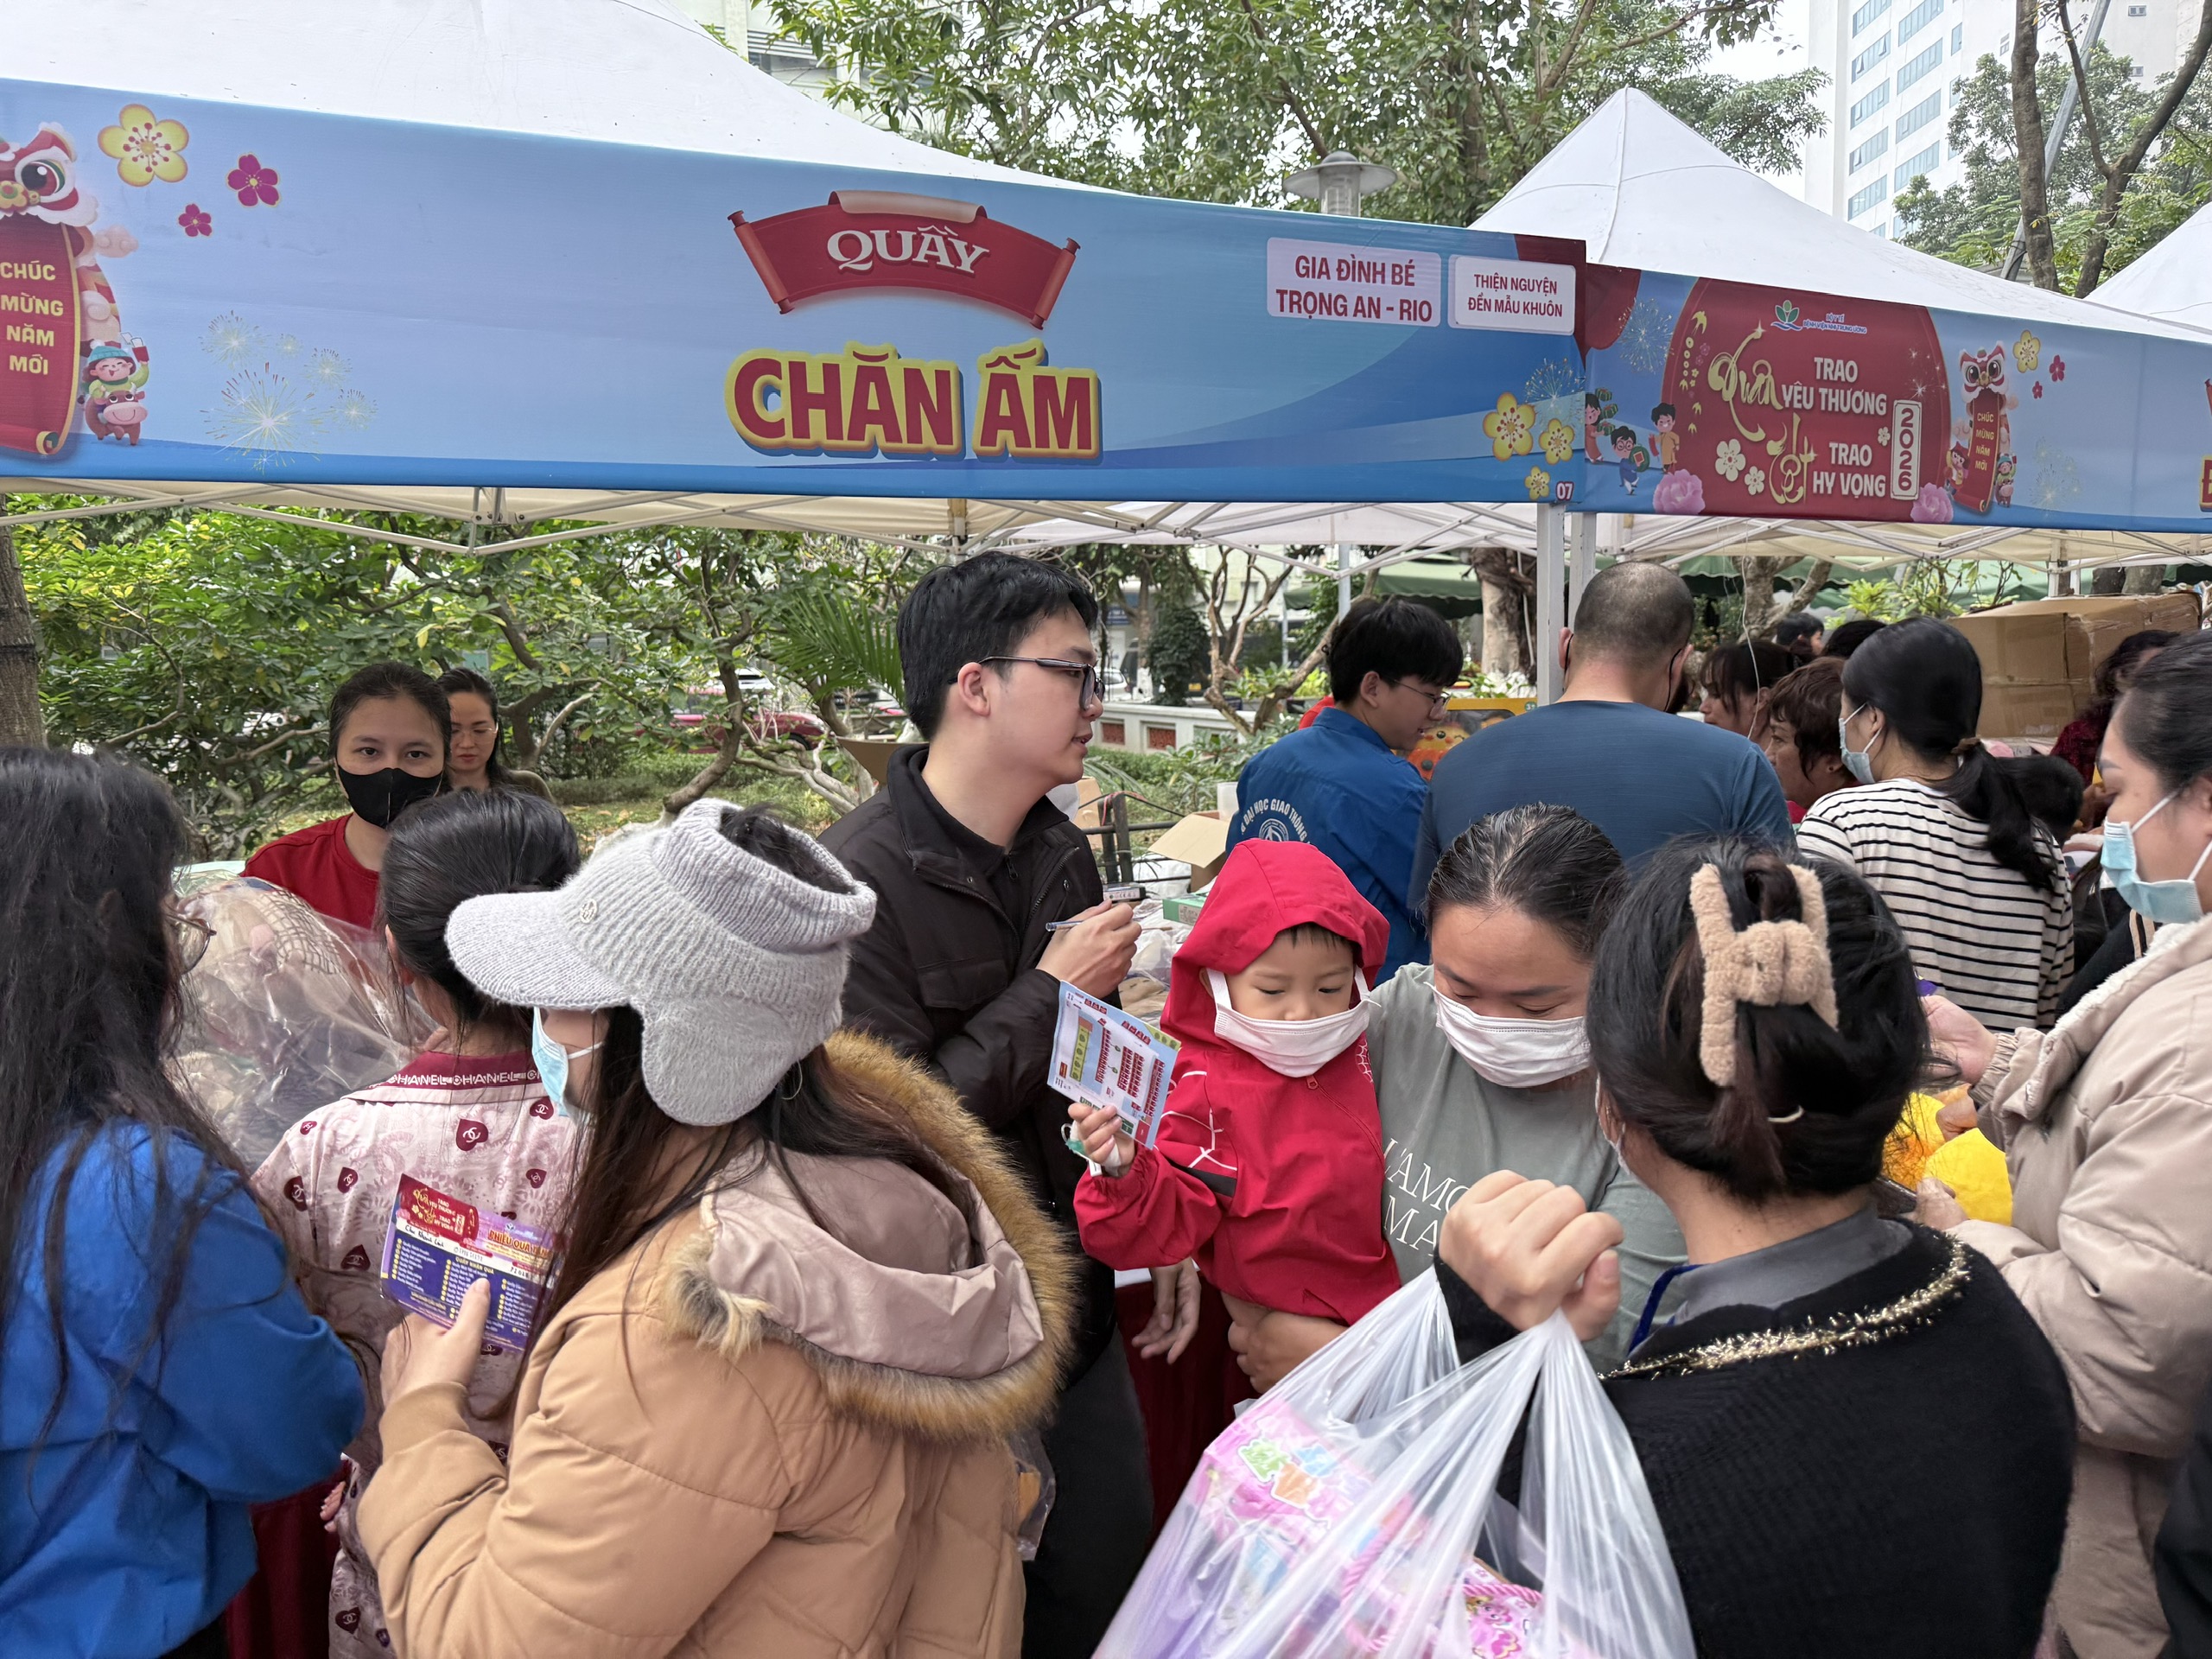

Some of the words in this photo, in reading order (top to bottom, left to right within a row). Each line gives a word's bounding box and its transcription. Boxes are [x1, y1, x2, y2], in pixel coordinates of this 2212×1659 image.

[826, 225, 989, 273] QUẦY
[0, 260, 56, 281] CHÚC
[1295, 255, 1331, 281] GIA
[1336, 253, 1385, 285] ĐÌNH
[1391, 260, 1415, 287] BÉ
[1474, 273, 1508, 292] THIỆN
[1510, 276, 1557, 296] NGUYỆN
[1, 292, 64, 316] MỪNG
[1276, 289, 1347, 320] TRỌNG
[1353, 296, 1381, 319] AN
[1399, 300, 1433, 322] RIO
[1468, 293, 1492, 312] ĐỀN
[1495, 294, 1520, 314] MẪU
[1523, 301, 1562, 317] KHUÔN
[6, 323, 54, 346] NĂM
[9, 353, 48, 375] MỚI
[1815, 357, 1859, 384] TRAO
[733, 350, 955, 446] CHĂN
[978, 347, 1093, 450] ẤM
[1782, 381, 1815, 410] YÊU
[1819, 385, 1887, 416] THƯƠNG
[1977, 411, 1993, 423] CHÚC
[1829, 442, 1872, 467] TRAO
[1898, 407, 1915, 493] 2026
[1975, 444, 1991, 457] NĂM
[1556, 481, 1573, 501] 07
[1813, 471, 1836, 495] HY
[1840, 474, 1886, 499] VỌNG
[1243, 810, 1255, 826] ĐẠI
[1253, 798, 1269, 815] HỌC
[1270, 798, 1289, 815] GIAO
[1288, 808, 1307, 842] THÔNG
[452, 1071, 519, 1085] CHANEL
